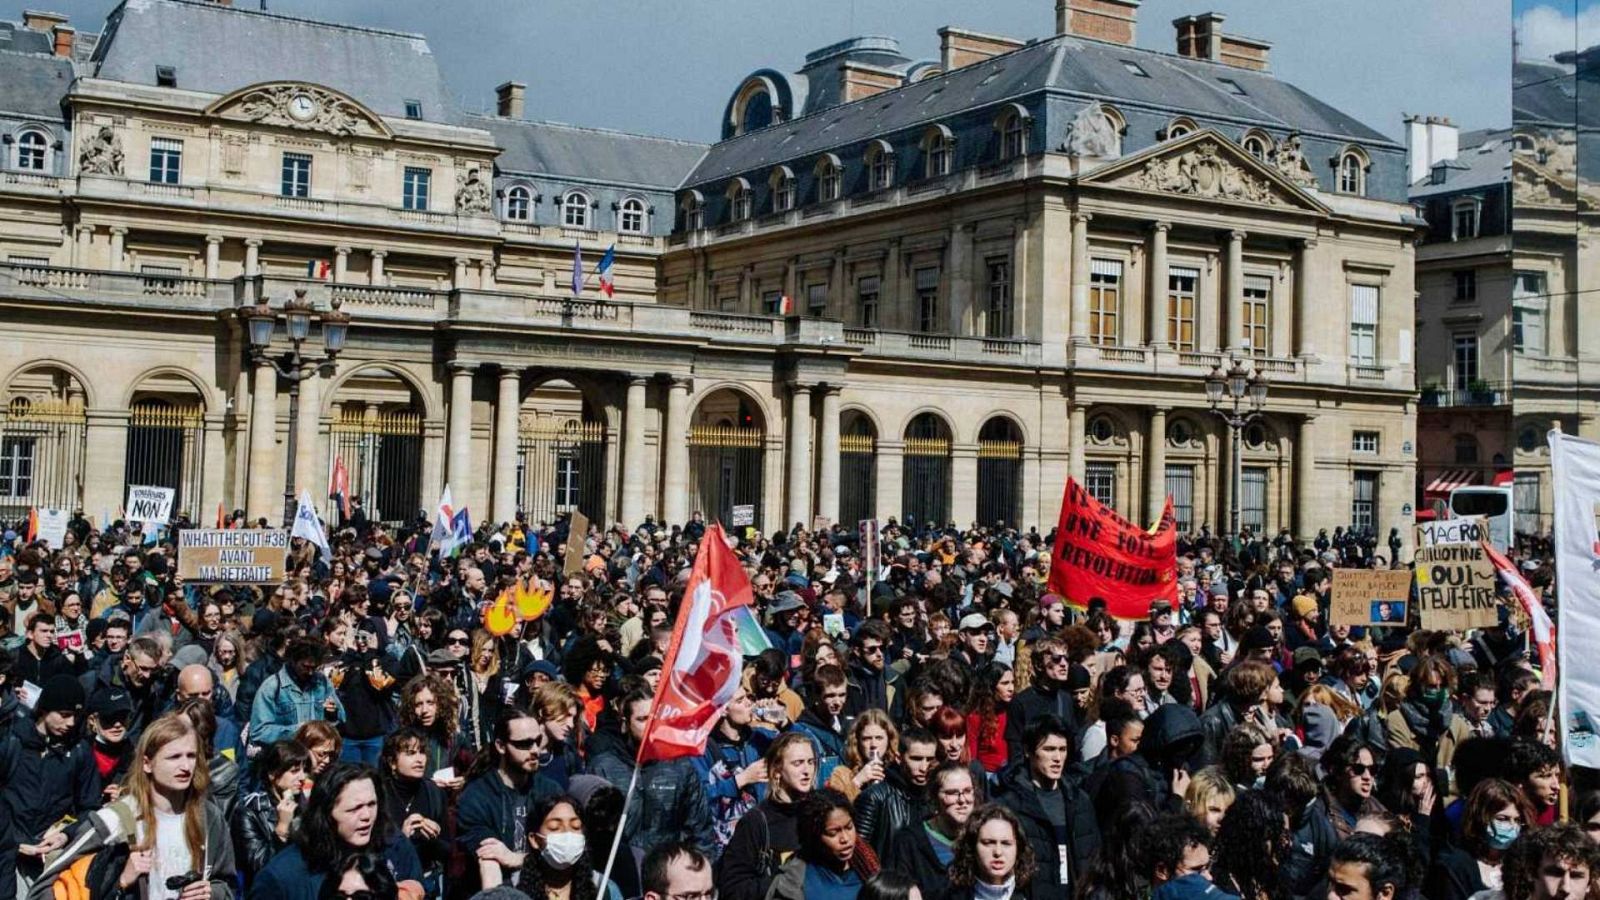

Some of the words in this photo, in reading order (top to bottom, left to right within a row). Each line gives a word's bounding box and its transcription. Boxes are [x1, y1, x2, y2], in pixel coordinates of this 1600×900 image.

[183, 531, 217, 547] WHAT
[220, 531, 240, 547] THE
[241, 531, 262, 547] CUT
[1416, 523, 1490, 546] MACRON
[220, 550, 253, 563] AVANT
[1413, 545, 1483, 562] GUILLOTINE
[200, 566, 217, 580] MA
[220, 566, 271, 580] RETRAITE
